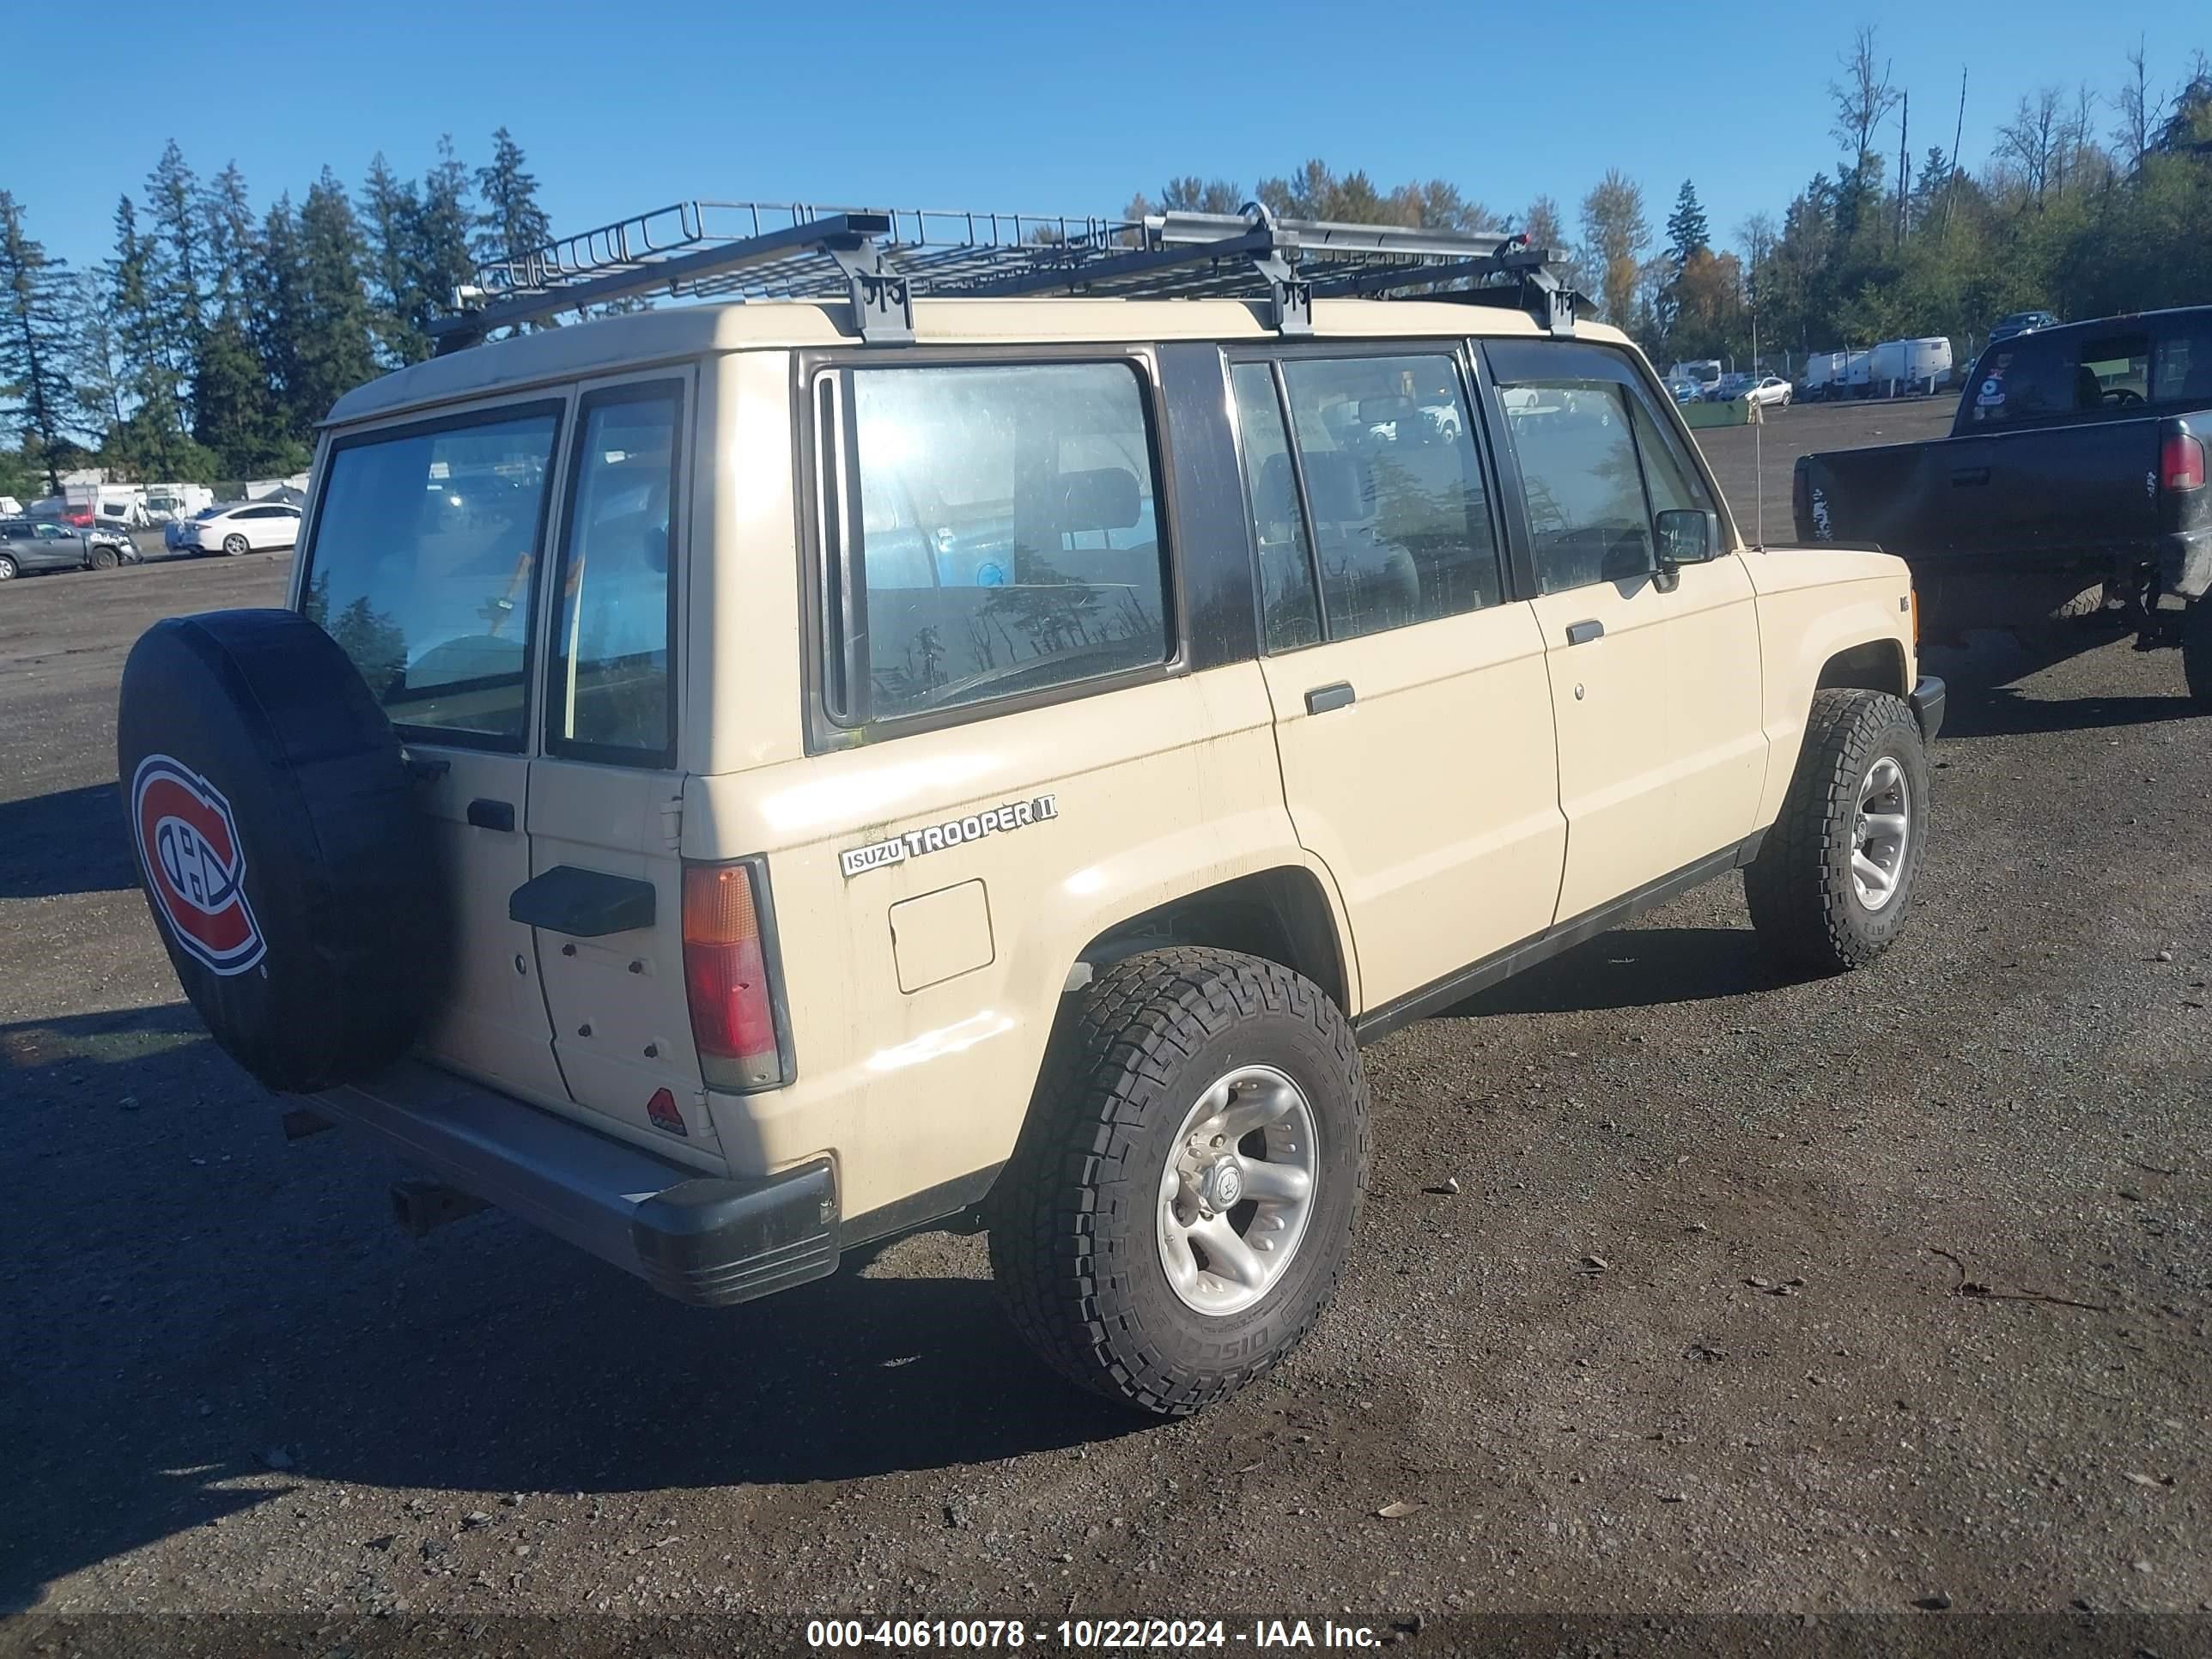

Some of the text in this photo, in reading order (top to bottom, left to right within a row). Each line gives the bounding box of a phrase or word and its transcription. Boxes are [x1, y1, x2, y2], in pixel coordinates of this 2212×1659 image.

[844, 794, 1058, 872] ISUZU TROOPER II
